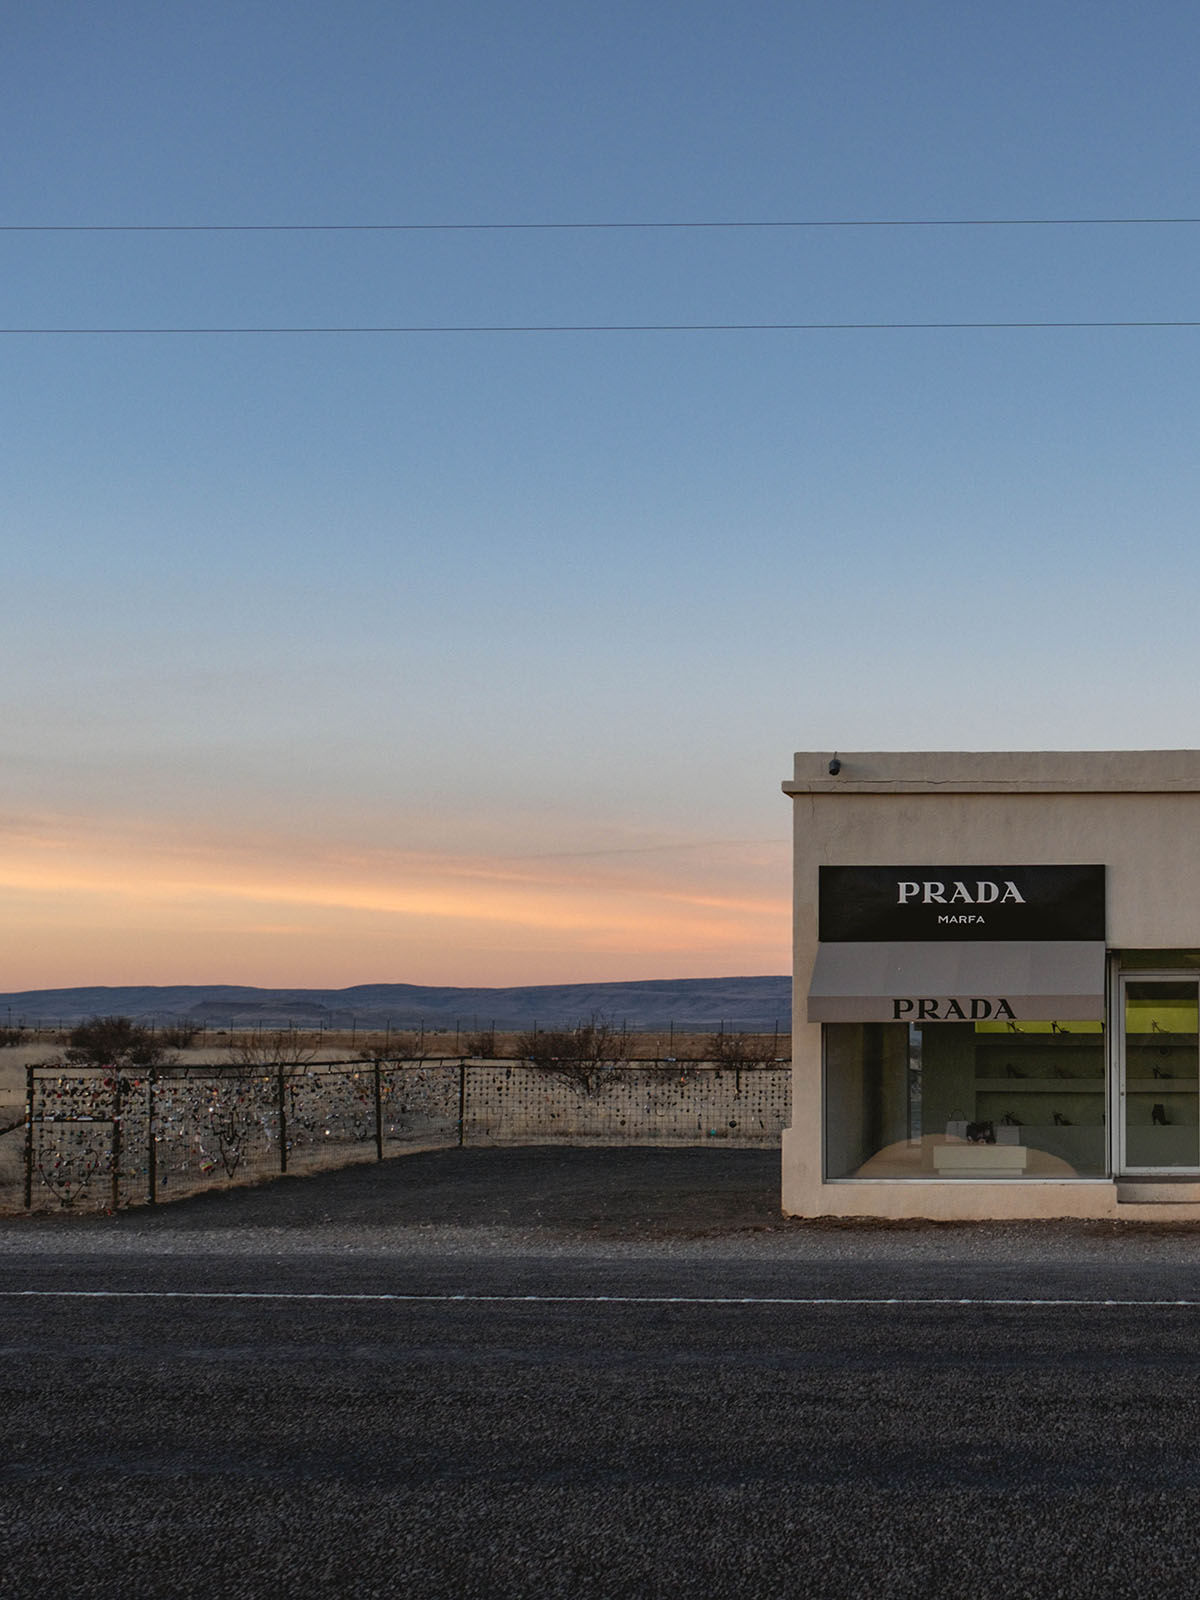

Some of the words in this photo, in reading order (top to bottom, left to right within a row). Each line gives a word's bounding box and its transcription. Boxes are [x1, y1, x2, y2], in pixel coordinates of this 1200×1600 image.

[896, 881, 1026, 904] PRADA
[937, 915, 985, 924] MARFA
[892, 998, 1017, 1020] PRADA
